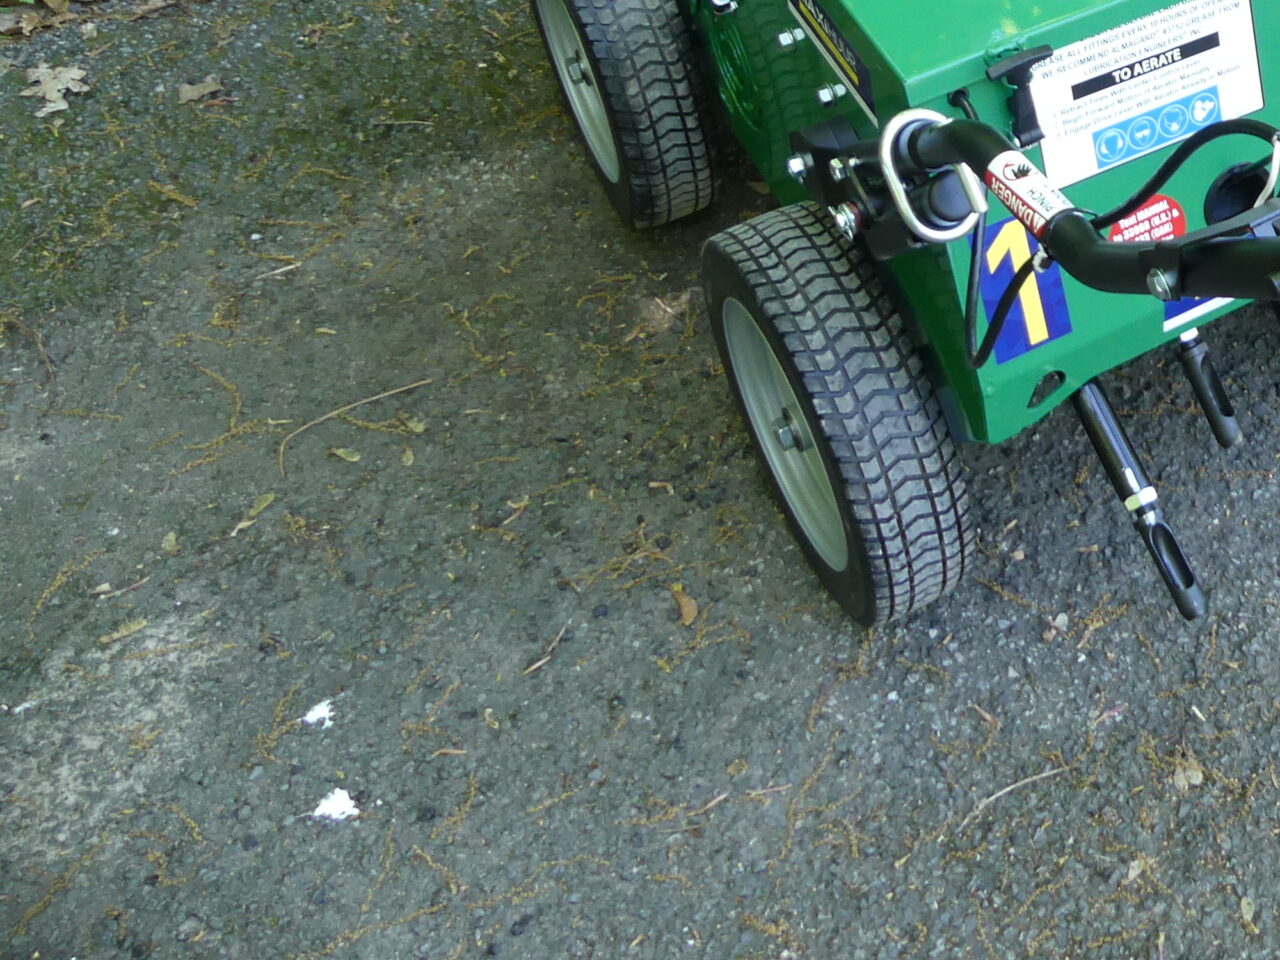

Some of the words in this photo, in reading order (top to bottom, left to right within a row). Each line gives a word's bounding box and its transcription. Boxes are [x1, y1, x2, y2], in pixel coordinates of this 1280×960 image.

[1041, 70, 1053, 79] WE
[1056, 49, 1109, 73] RECOMMEND
[1185, 10, 1217, 26] GREASE
[1218, 1, 1240, 13] FROM
[1066, 46, 1080, 58] ALL
[1083, 32, 1119, 51] FITTINGS
[1121, 23, 1146, 37] EVERY
[1159, 9, 1187, 23] HOURS
[1189, 4, 1199, 13] OF
[1083, 51, 1136, 75] LUBRICATION
[1112, 67, 1132, 83] TO
[1132, 48, 1181, 75] AERATE
